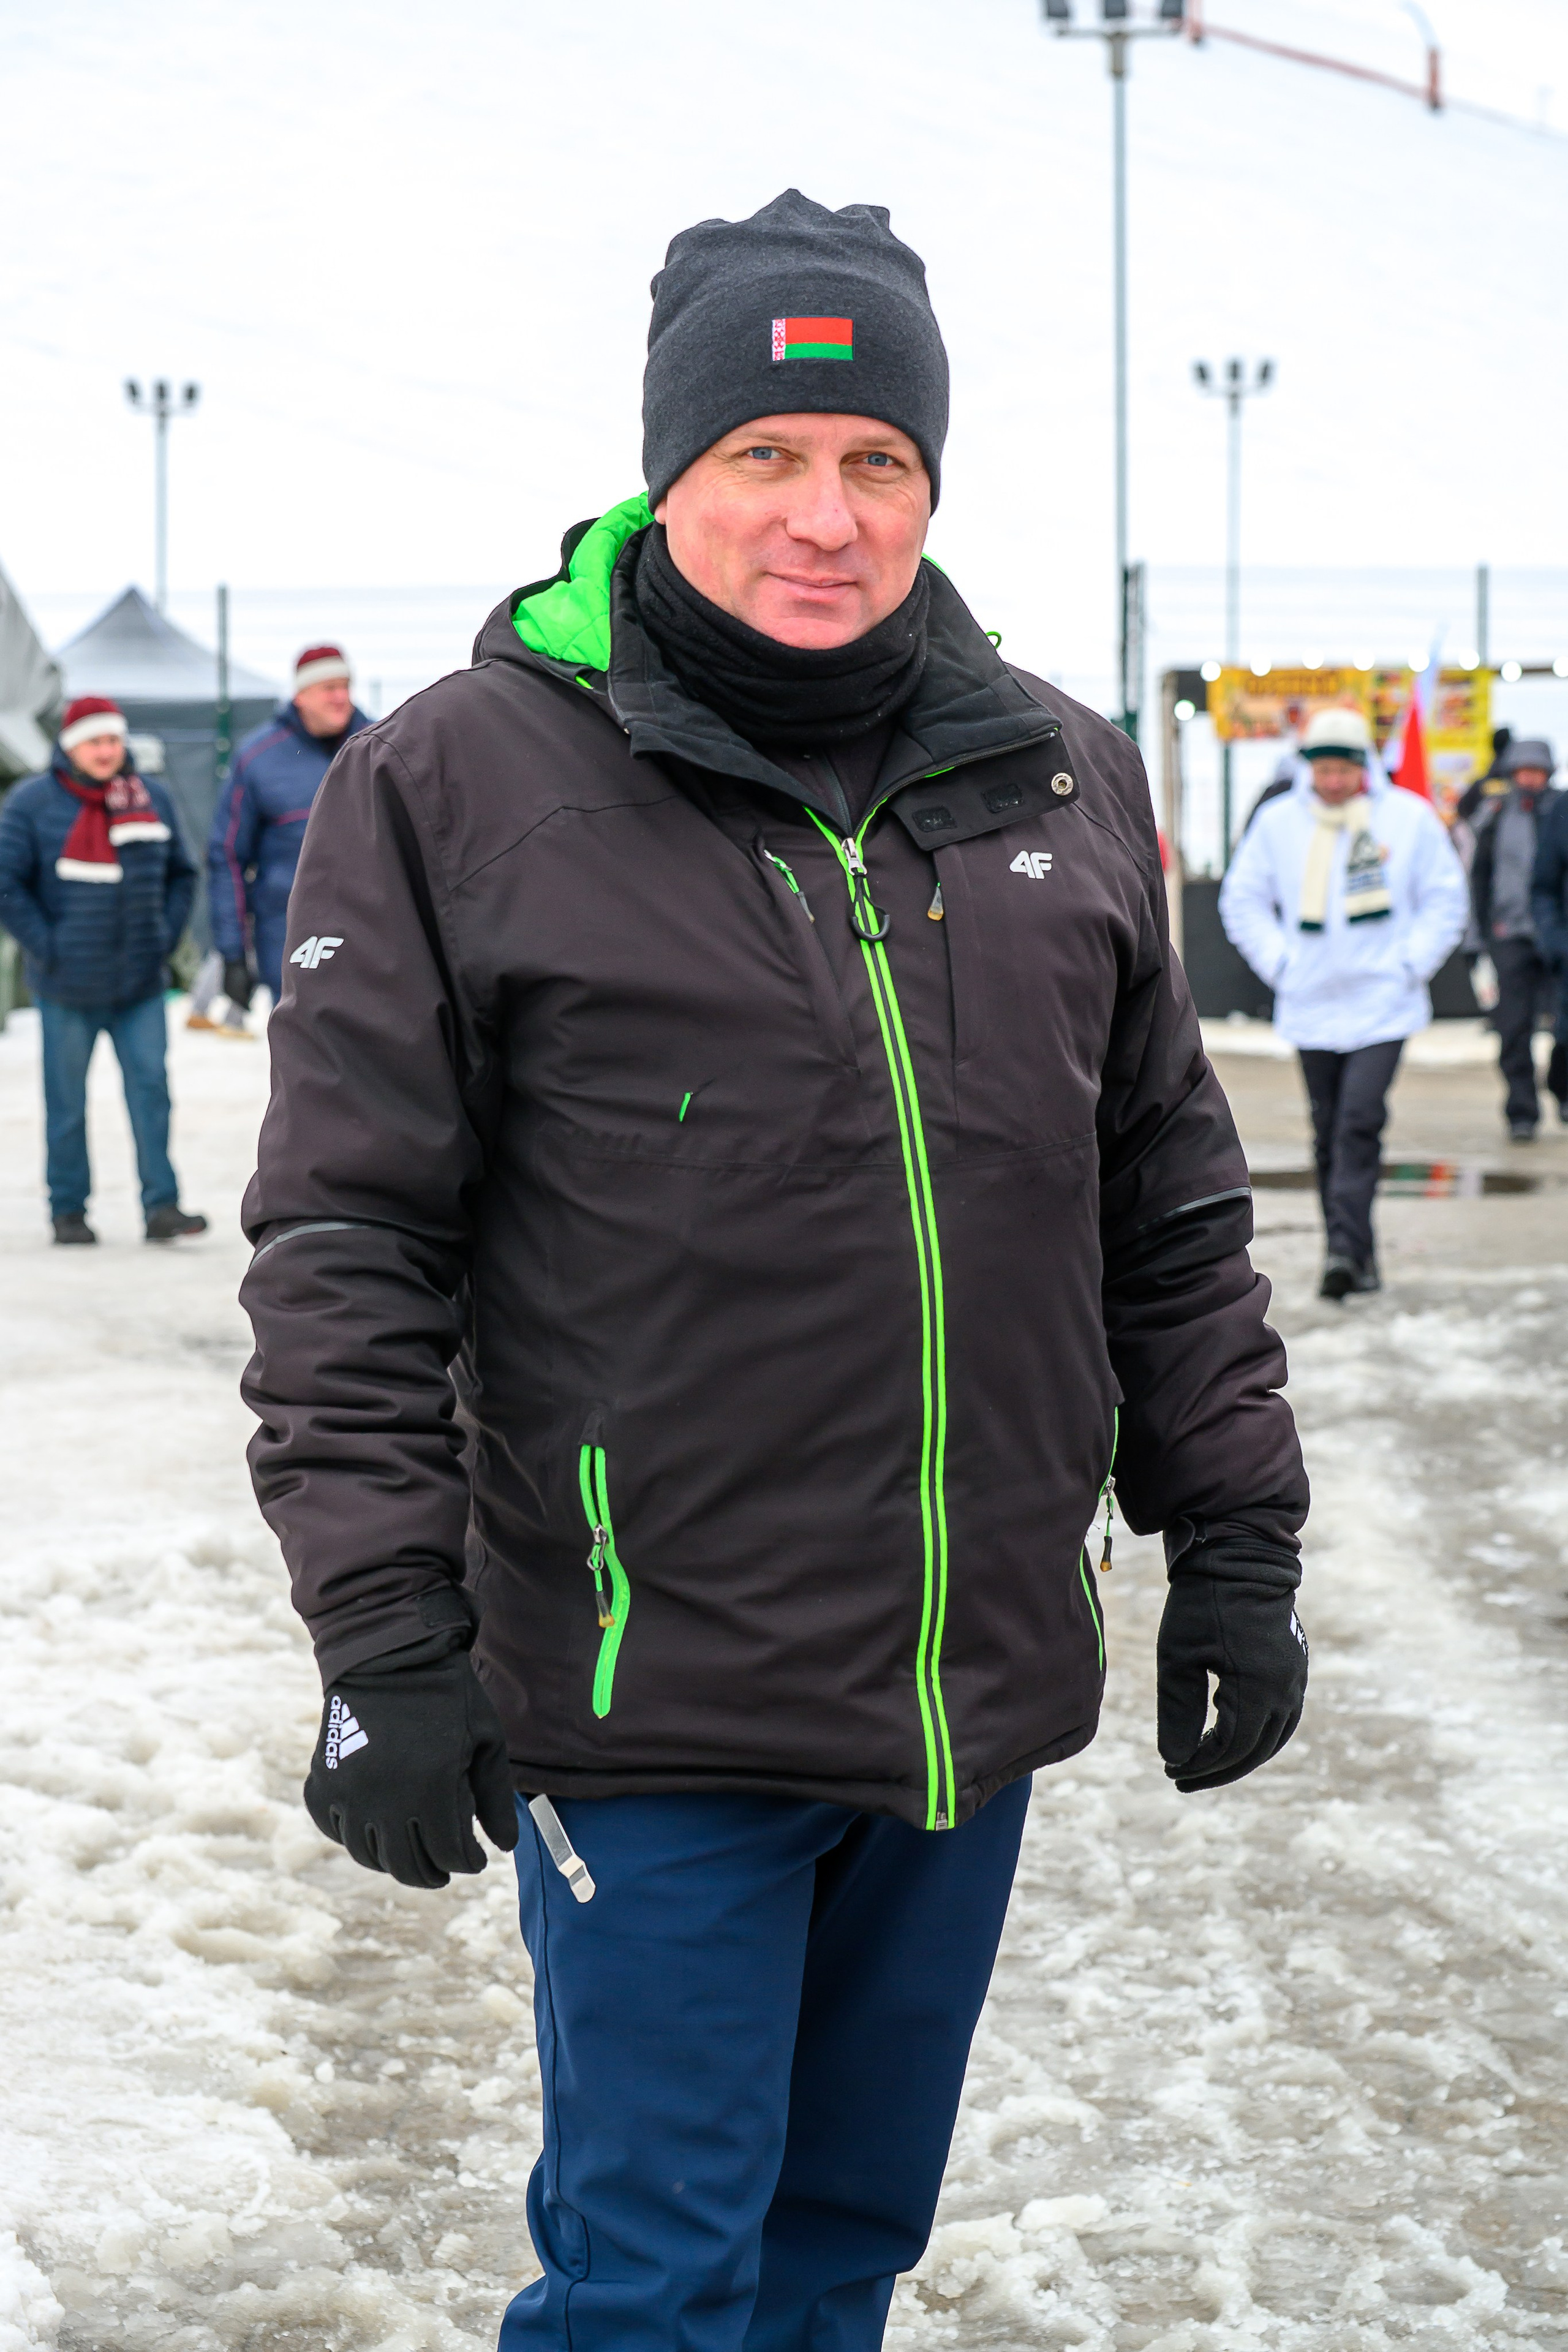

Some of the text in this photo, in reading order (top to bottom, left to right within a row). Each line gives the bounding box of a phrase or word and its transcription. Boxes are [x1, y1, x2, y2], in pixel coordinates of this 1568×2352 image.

[1009, 850, 1052, 879] 4F
[289, 936, 344, 968] 4F
[325, 1695, 343, 1769] adidas
